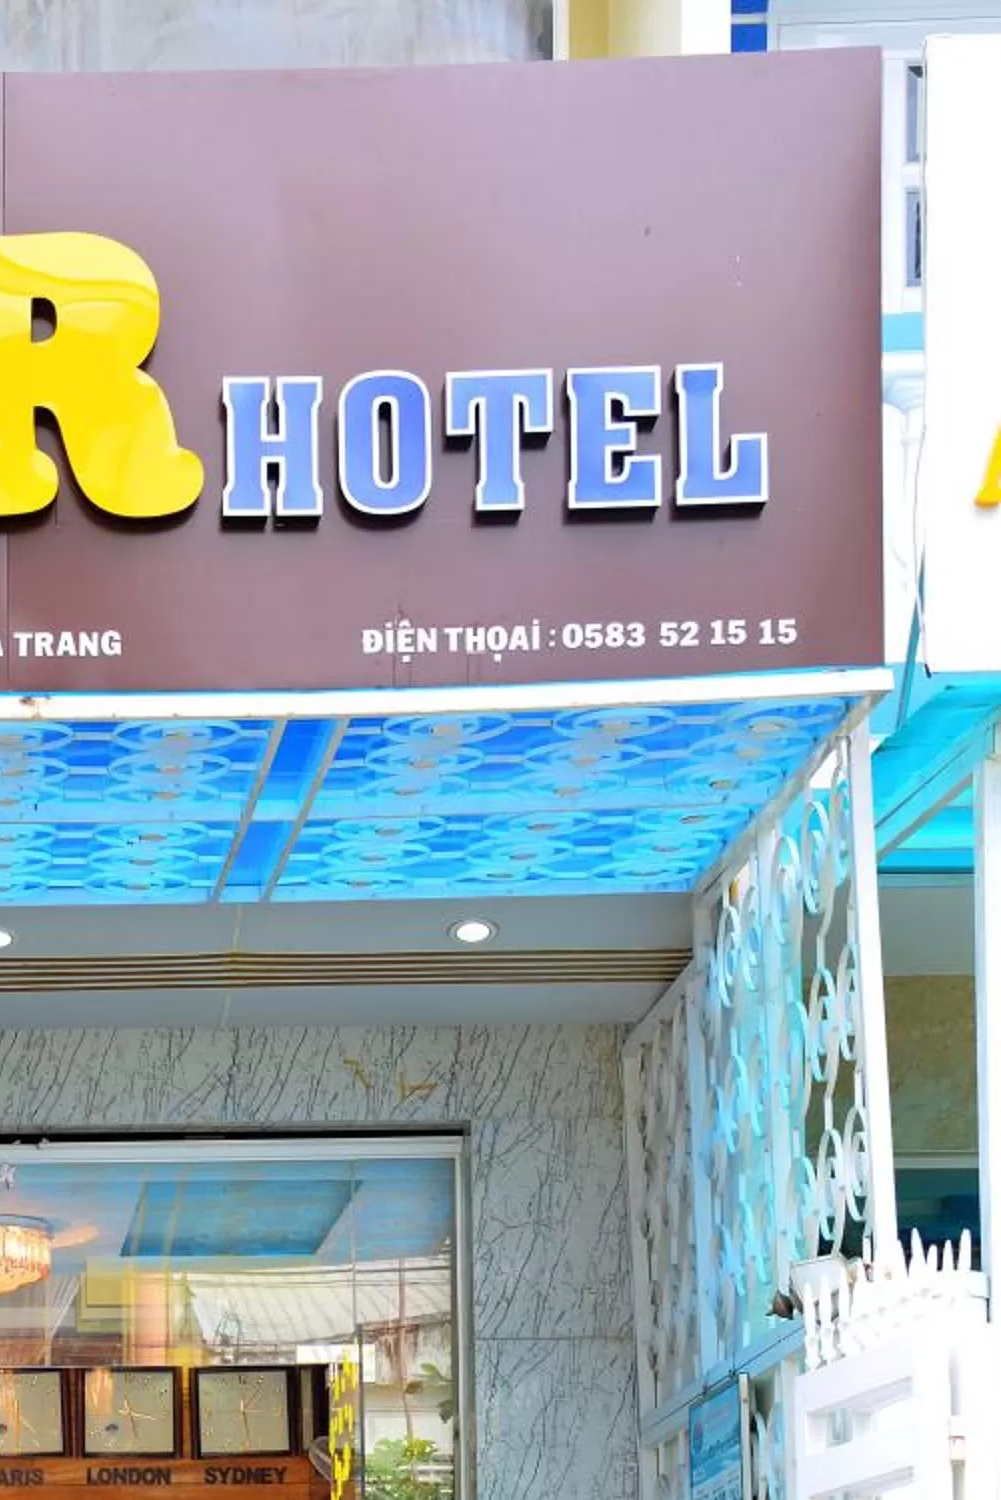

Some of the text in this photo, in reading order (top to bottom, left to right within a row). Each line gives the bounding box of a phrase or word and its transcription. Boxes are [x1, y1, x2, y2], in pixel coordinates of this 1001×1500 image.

[221, 363, 768, 517] HOTEL
[13, 630, 122, 658] TRANG
[562, 621, 647, 649] 0583
[658, 620, 700, 647] 52
[710, 618, 748, 645] 15
[758, 617, 798, 645] 15
[86, 1467, 171, 1485] LONDON
[204, 1466, 287, 1485] SYDNEY
